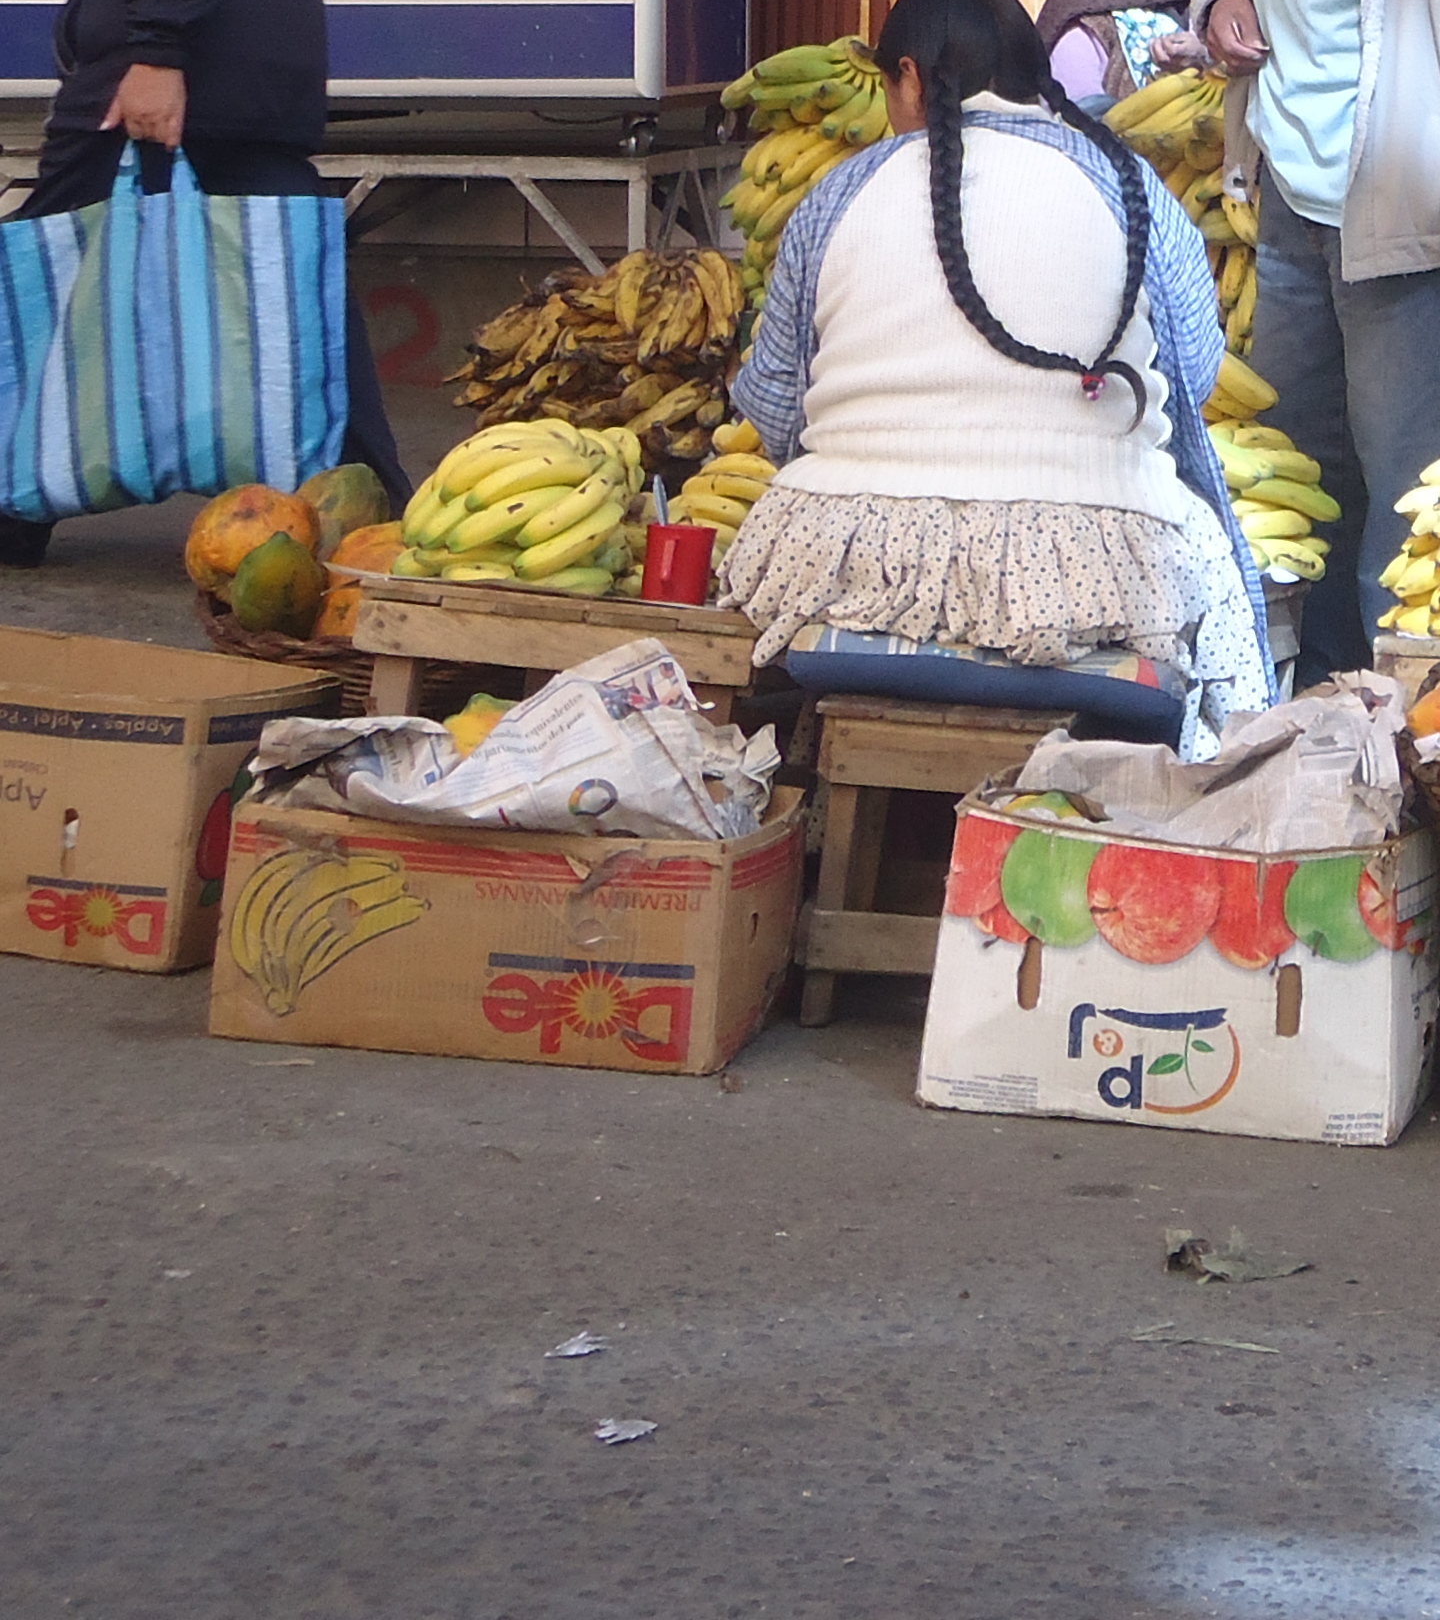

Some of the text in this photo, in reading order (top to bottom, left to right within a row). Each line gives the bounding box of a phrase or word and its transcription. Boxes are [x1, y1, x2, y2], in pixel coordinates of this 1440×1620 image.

[33, 714, 84, 731] Apfel
[104, 718, 174, 736] Apples
[474, 881, 571, 906] ANANAS
[26, 886, 168, 956] Dole
[482, 972, 695, 1063] Dole
